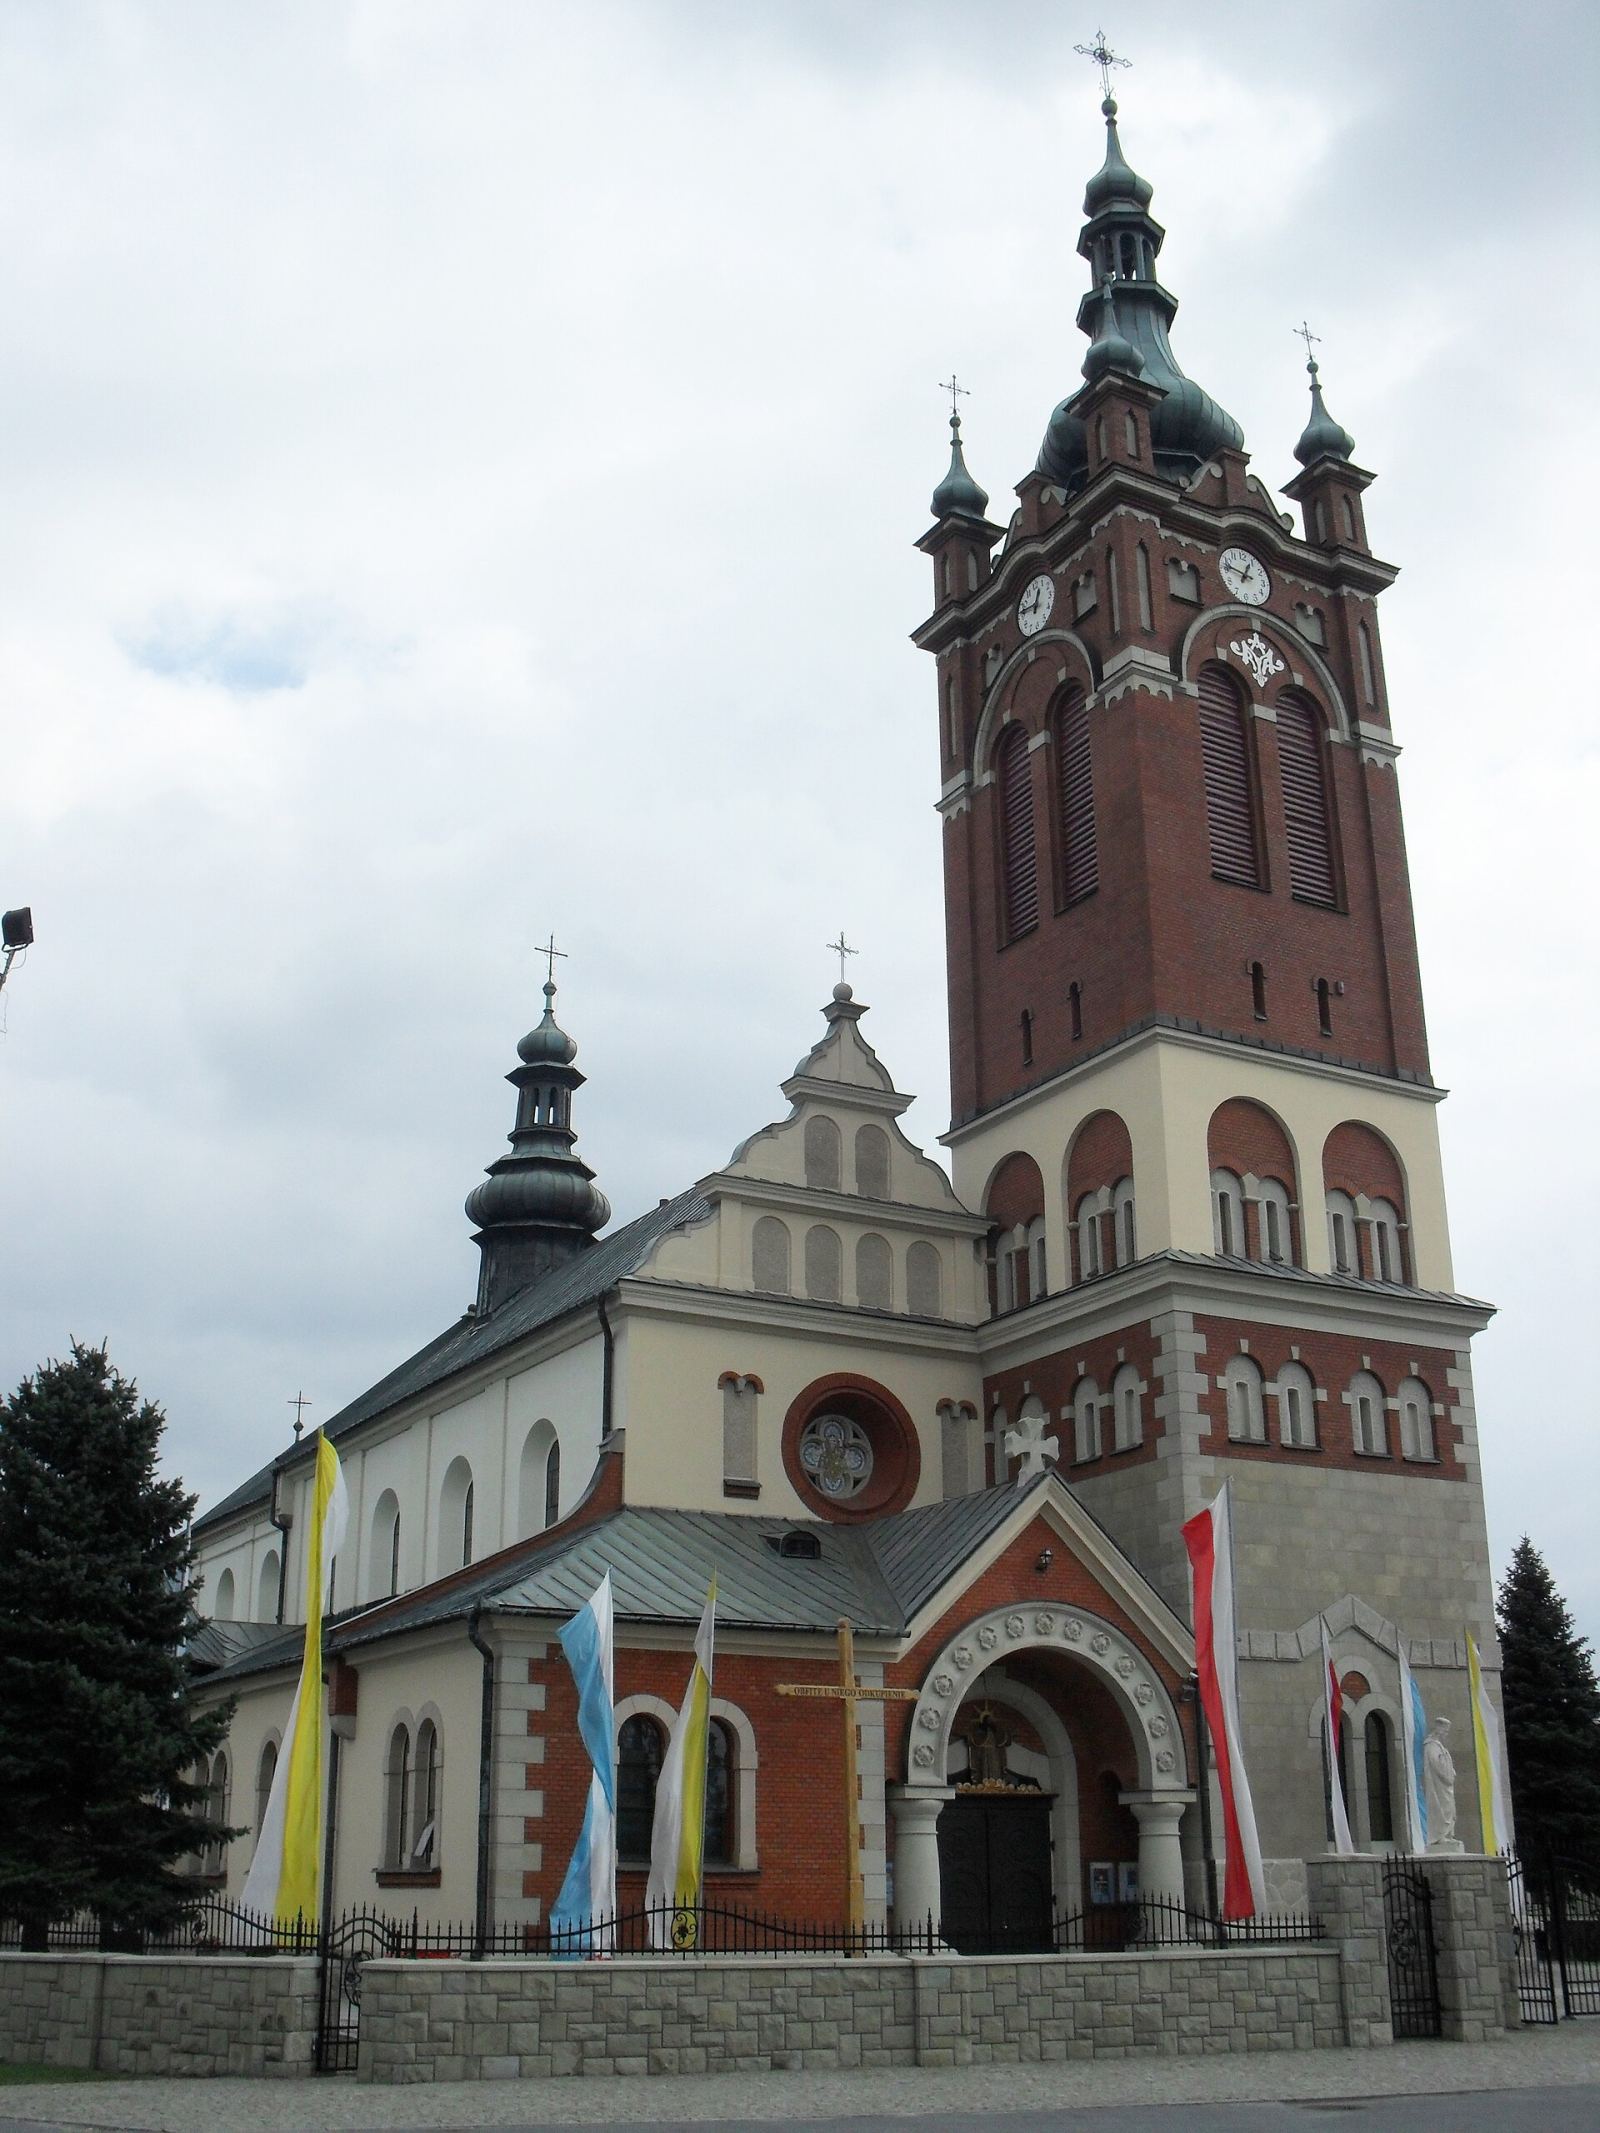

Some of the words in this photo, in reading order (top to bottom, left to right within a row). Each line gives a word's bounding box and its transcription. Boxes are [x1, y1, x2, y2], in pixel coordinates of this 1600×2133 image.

[1231, 551, 1237, 560] 11
[1239, 551, 1247, 561] 12
[831, 1688, 857, 1698] NIEGO
[858, 1689, 905, 1698] ODKUPIENIE
